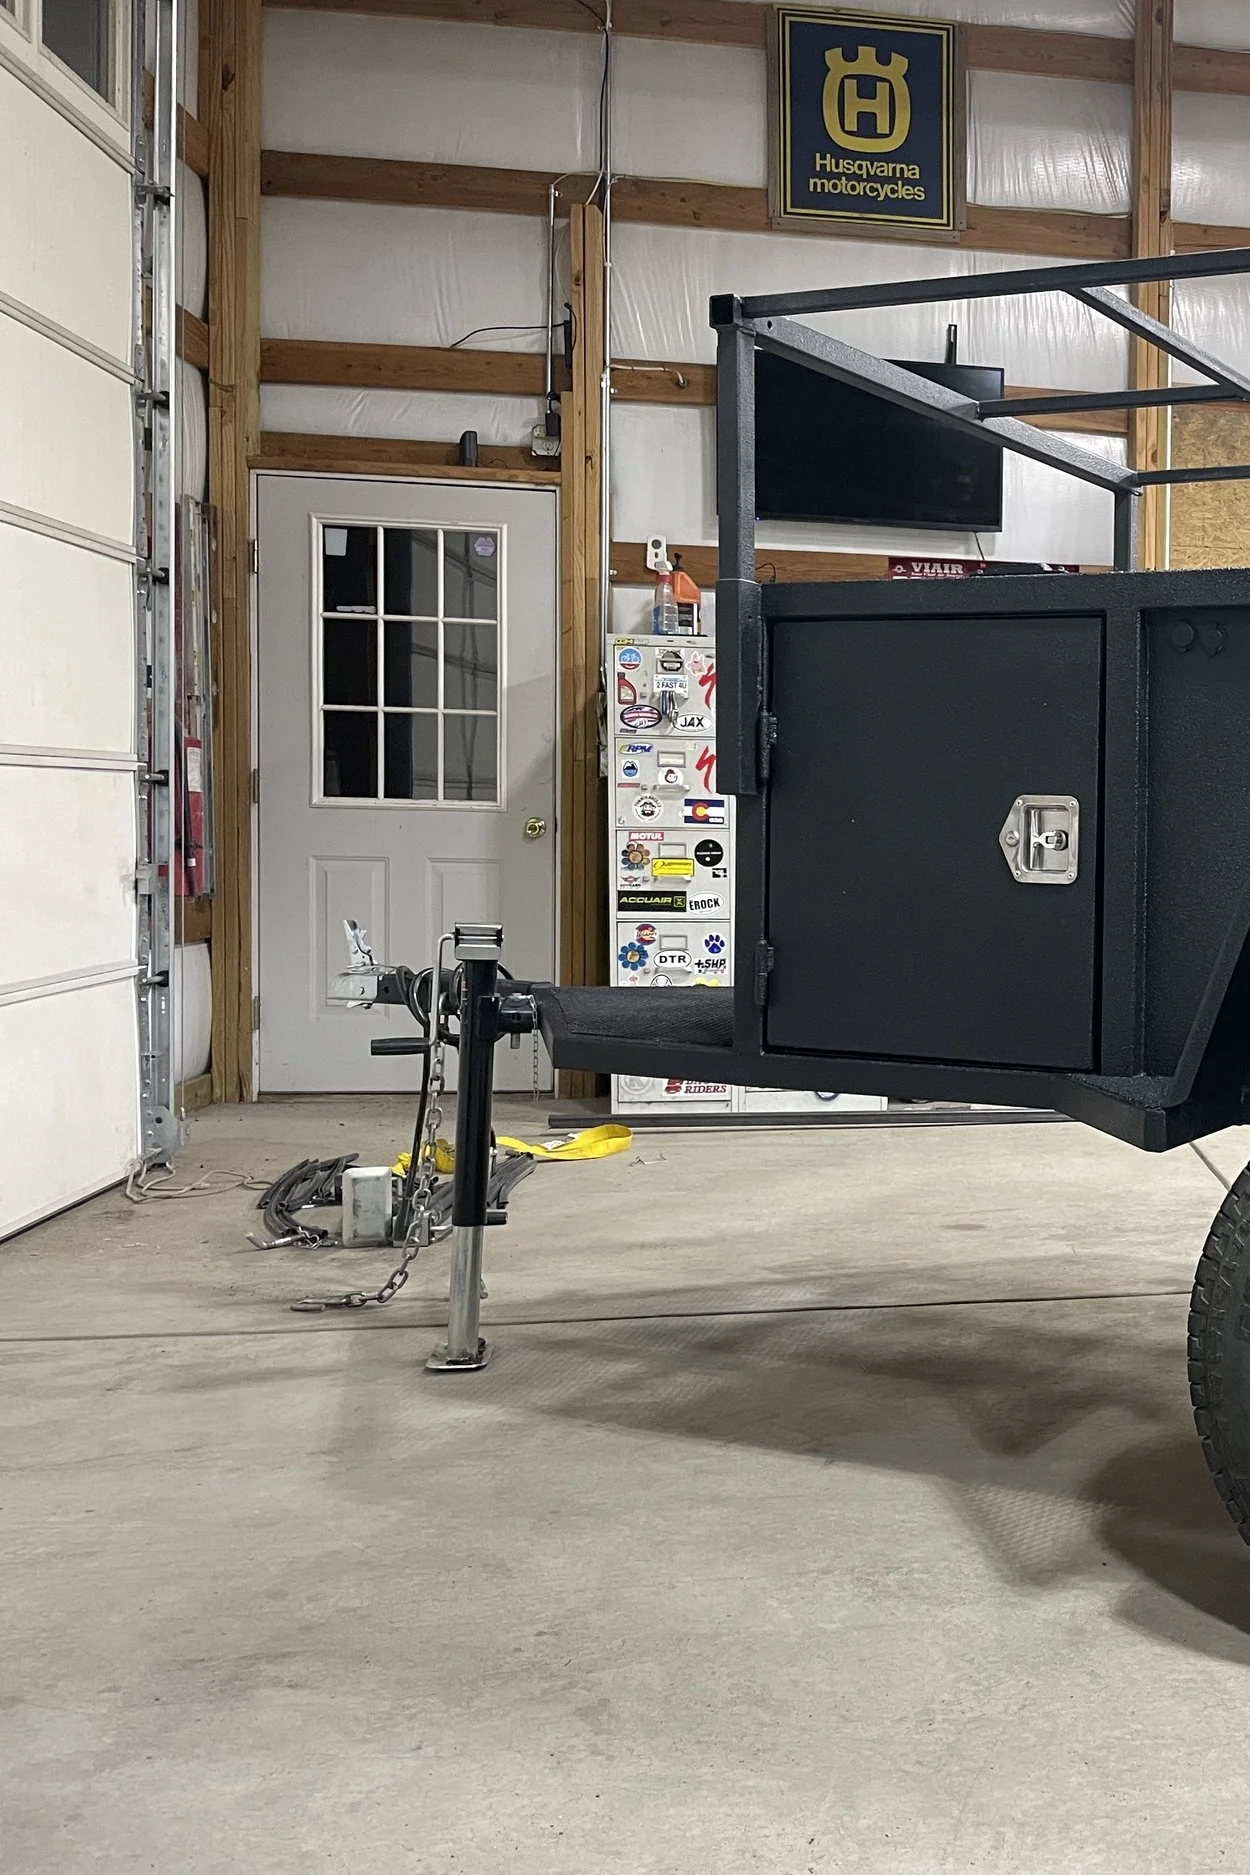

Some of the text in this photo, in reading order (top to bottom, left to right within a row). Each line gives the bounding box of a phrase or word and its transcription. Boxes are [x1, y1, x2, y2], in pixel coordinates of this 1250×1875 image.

[815, 153, 920, 180] Husqvarna
[809, 176, 925, 202] motorcycles
[911, 561, 964, 574] VIAIR
[680, 716, 705, 728] JAX
[689, 898, 720, 910] EROCK
[659, 955, 687, 964] DTR
[684, 1085, 727, 1094] RIDERS
